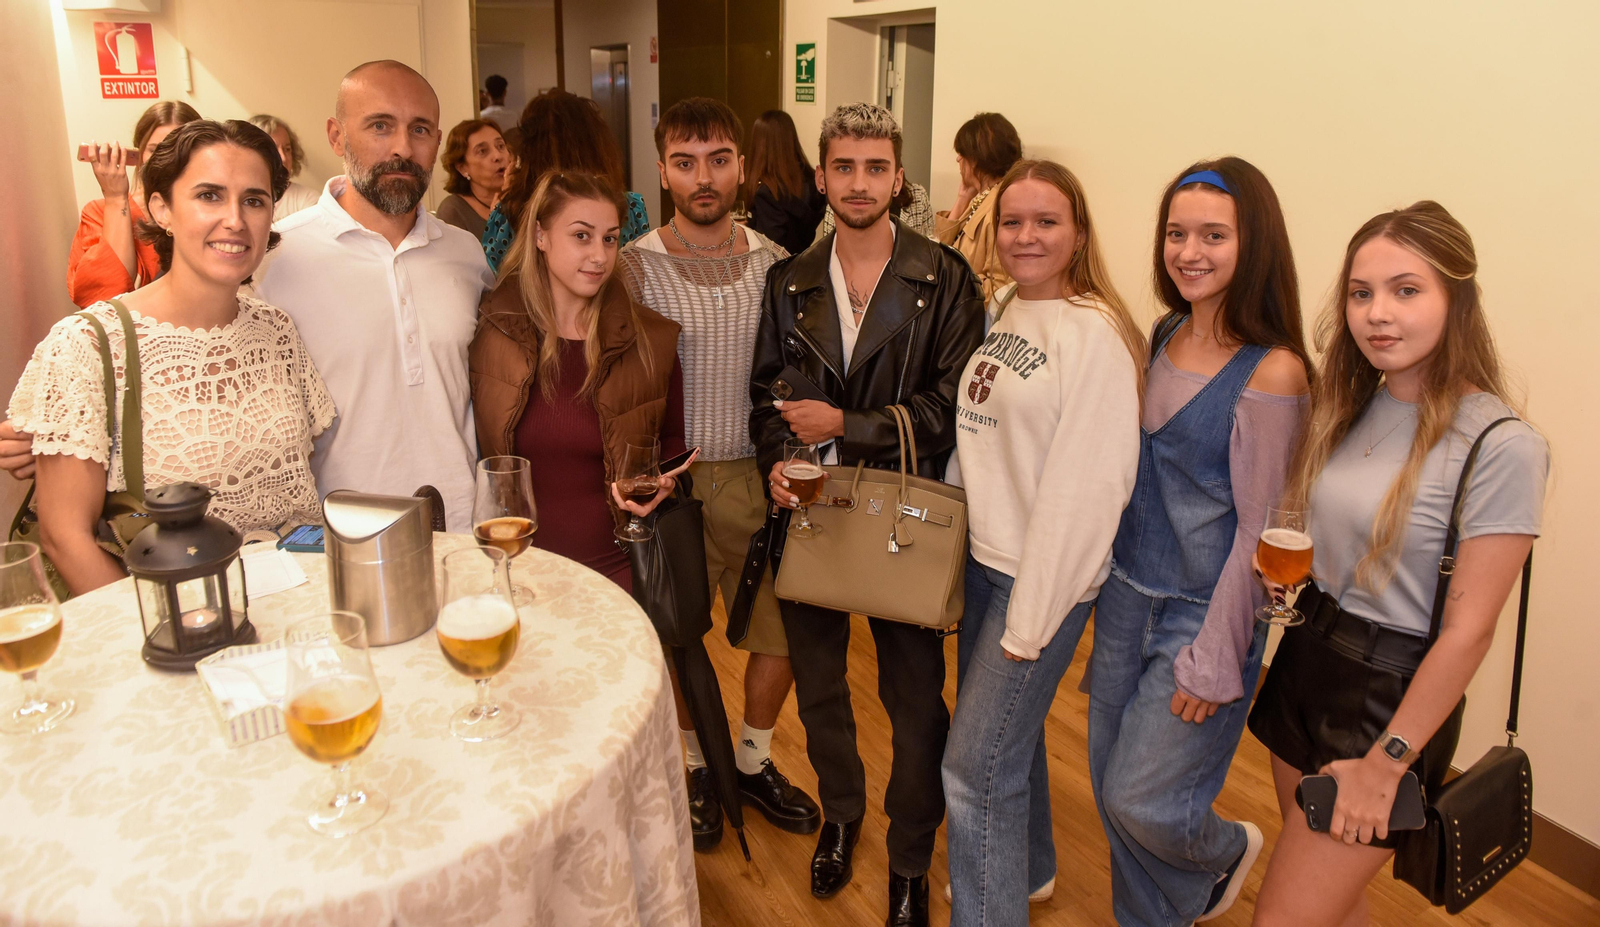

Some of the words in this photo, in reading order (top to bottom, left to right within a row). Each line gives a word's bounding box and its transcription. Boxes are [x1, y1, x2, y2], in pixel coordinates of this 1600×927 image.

[103, 81, 157, 95] EXTINTOR
[974, 331, 1047, 380] MBRIDGE
[956, 404, 998, 428] NIVERSITY
